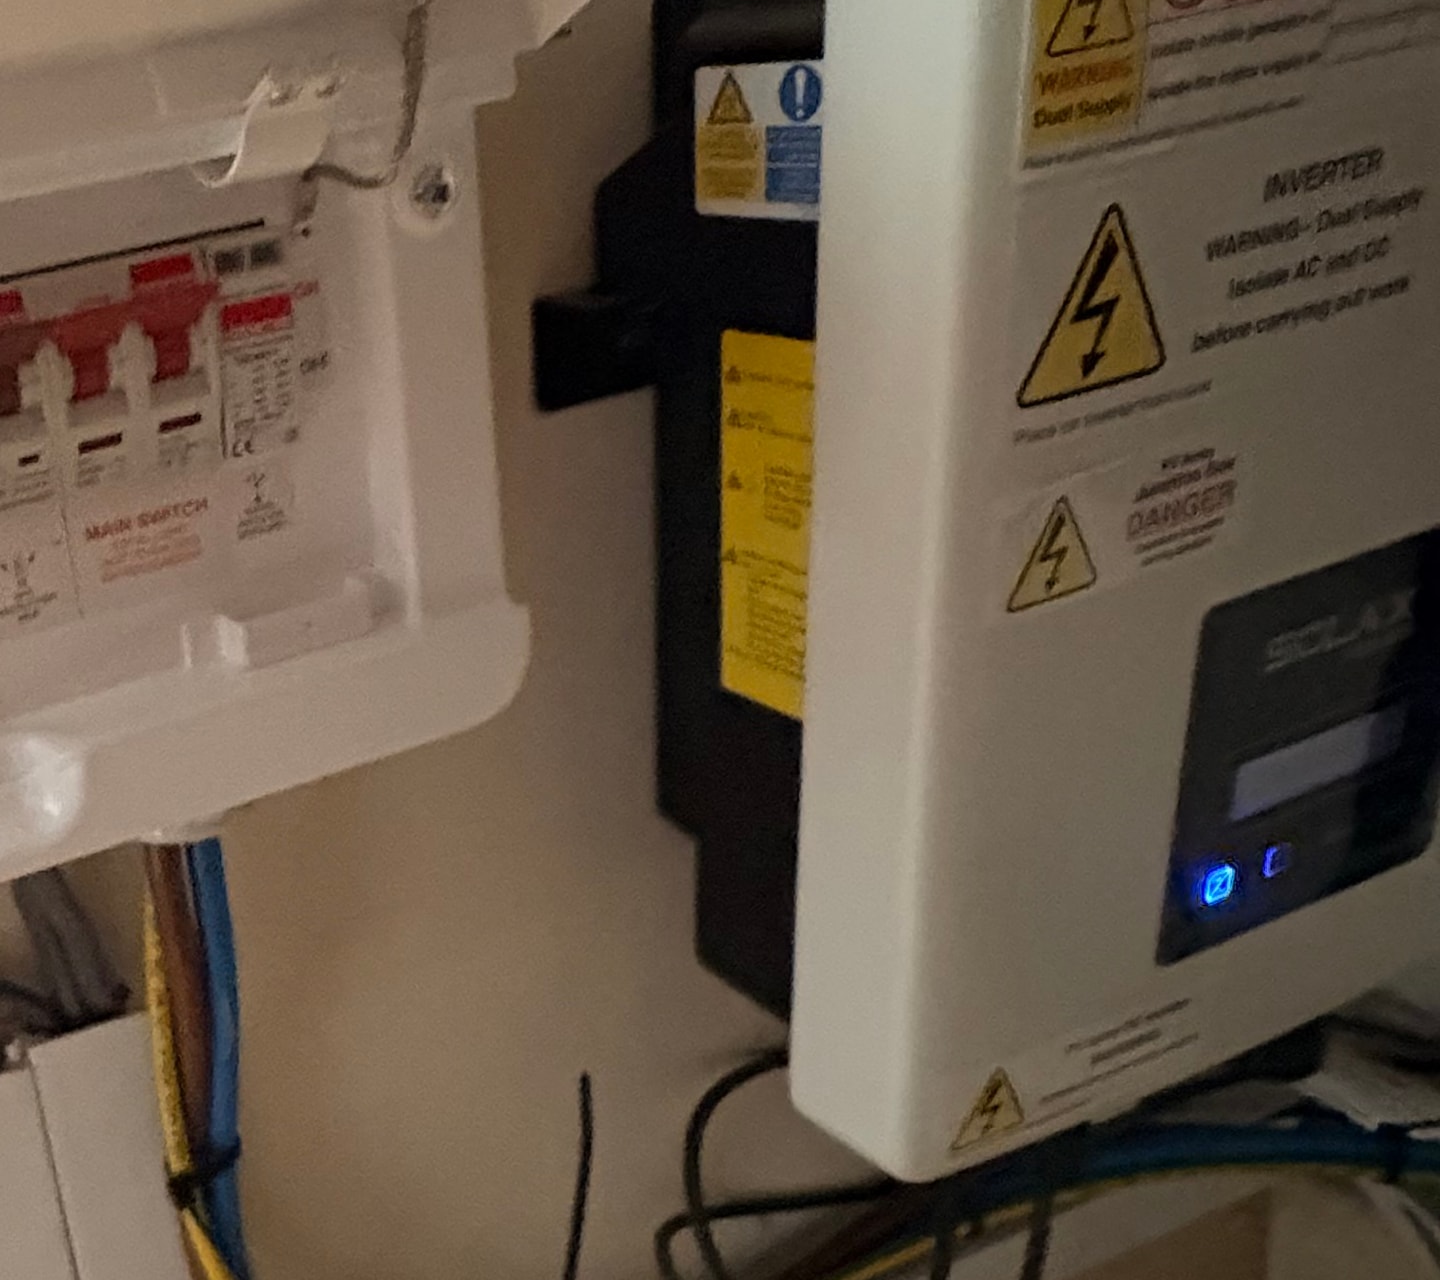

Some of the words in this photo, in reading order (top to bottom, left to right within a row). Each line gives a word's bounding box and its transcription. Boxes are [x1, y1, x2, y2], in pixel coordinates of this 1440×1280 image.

[1033, 102, 1073, 128] Dual
[1076, 92, 1134, 119] Supply
[1264, 146, 1384, 203] INVERTER
[1316, 208, 1351, 233] Dual
[1355, 187, 1424, 221] Supply
[1228, 267, 1290, 300] Isolate
[1293, 254, 1321, 279] AC
[1363, 235, 1391, 263] DC
[1191, 320, 1252, 352] before
[1256, 300, 1332, 333] carrying
[1368, 274, 1410, 302] work
[86, 517, 133, 542] MAIN
[136, 496, 208, 528] SWITCH
[1126, 480, 1237, 542] DANGER
